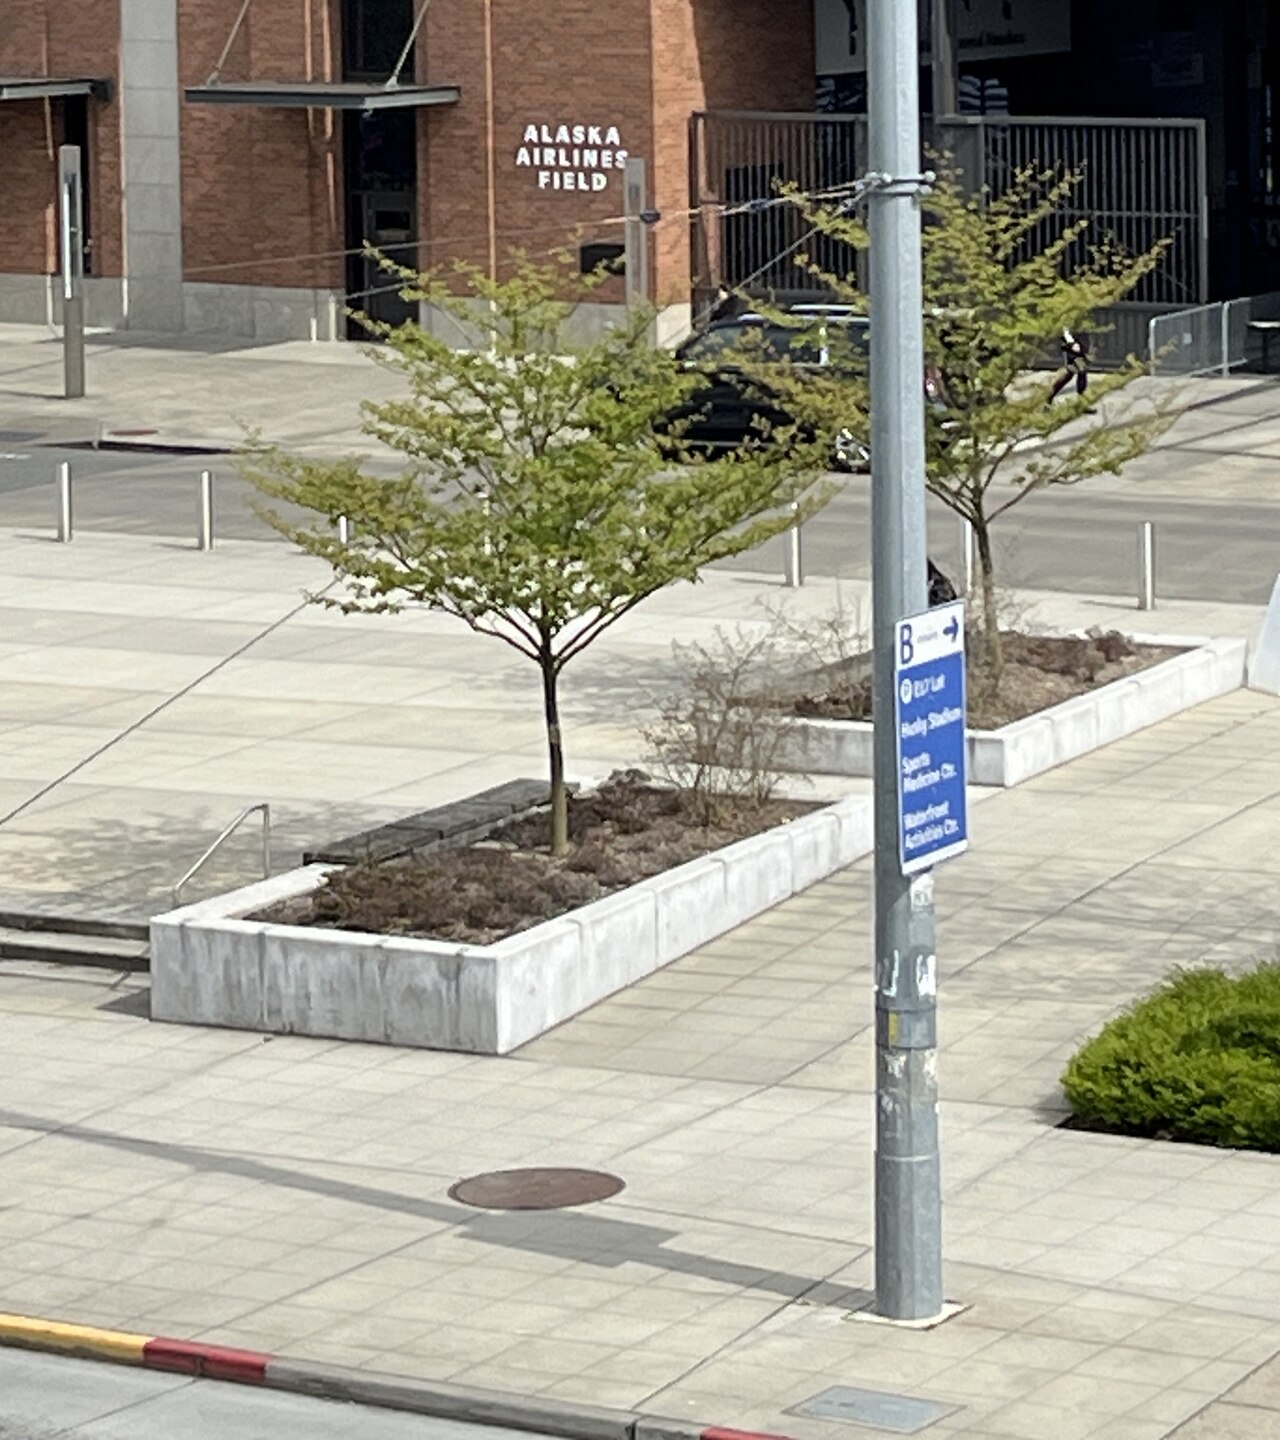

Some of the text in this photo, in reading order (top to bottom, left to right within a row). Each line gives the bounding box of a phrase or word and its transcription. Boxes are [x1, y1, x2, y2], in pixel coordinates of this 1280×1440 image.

[523, 125, 620, 146] ALASKA
[516, 147, 629, 169] AIRLINES
[538, 171, 608, 191] FIELD
[900, 623, 914, 664] B
